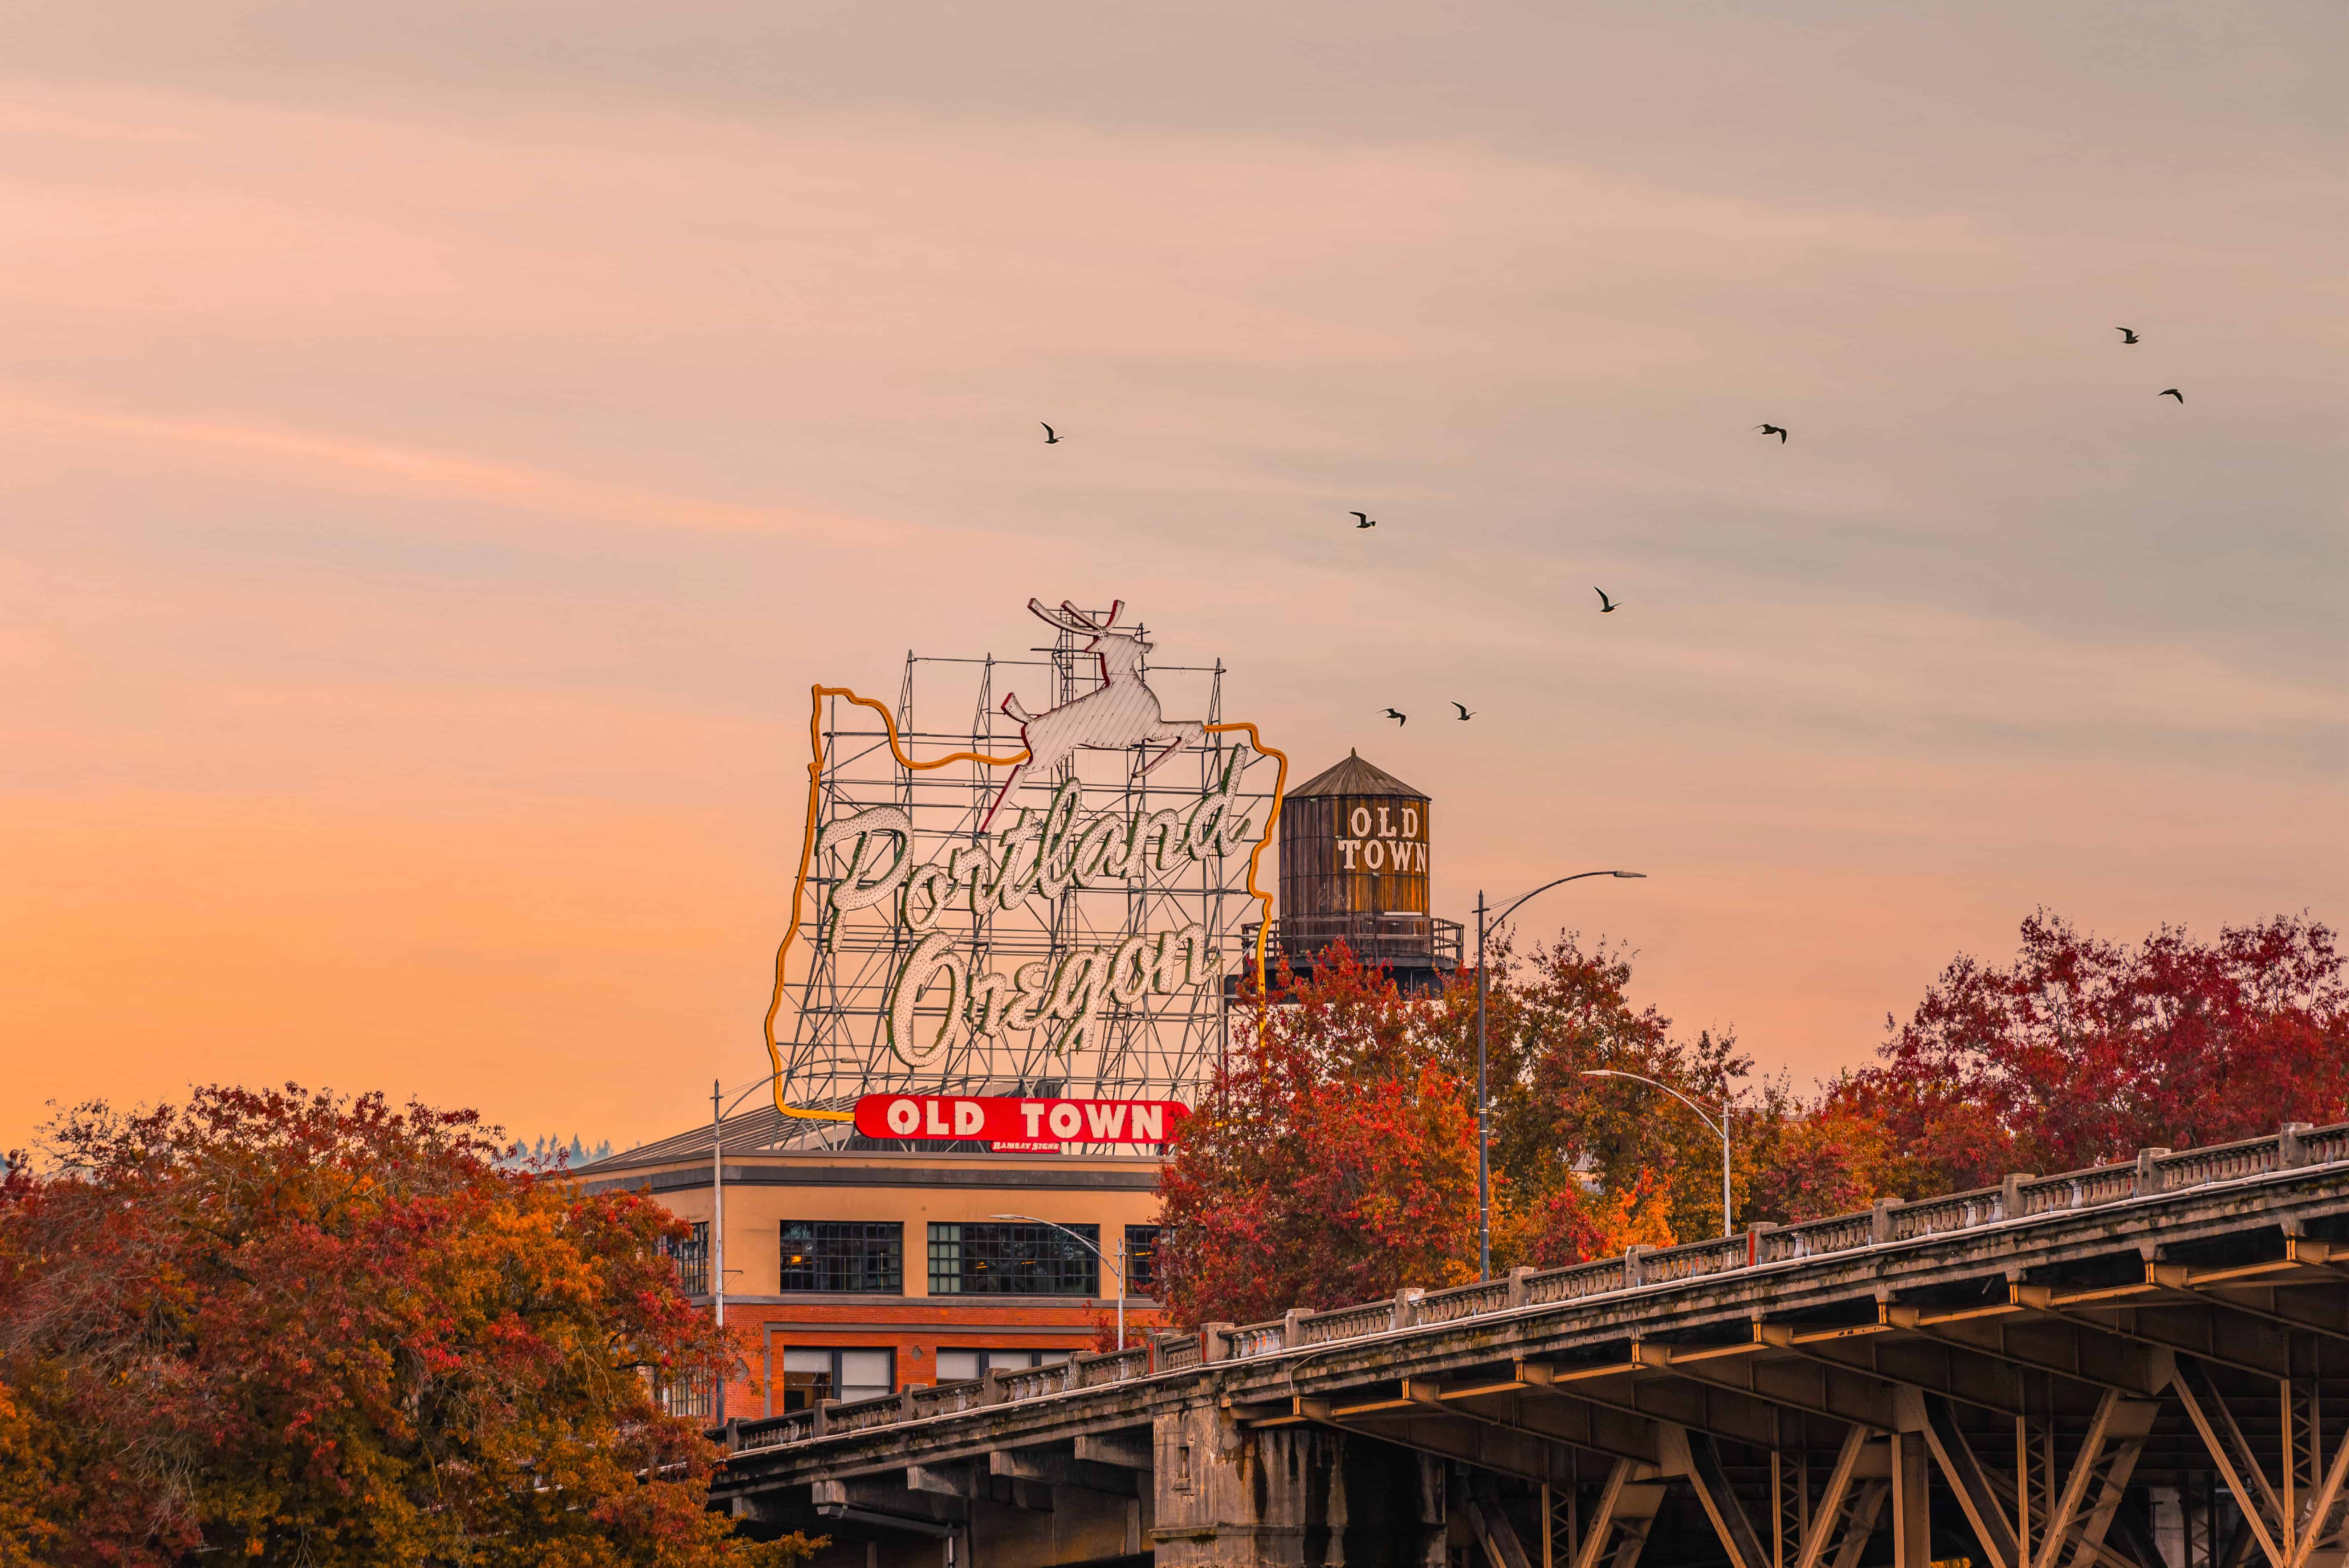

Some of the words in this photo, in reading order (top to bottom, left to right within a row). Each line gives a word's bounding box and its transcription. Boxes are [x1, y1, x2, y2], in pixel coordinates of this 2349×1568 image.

[1350, 807, 1418, 837] OLD
[815, 743, 1251, 953] Portland
[1338, 840, 1427, 872] TOWN
[887, 922, 1222, 1068] Oregon
[887, 1099, 984, 1135] OLD
[1021, 1103, 1163, 1139] TOWN
[992, 1141, 1031, 1150] RAMSAY
